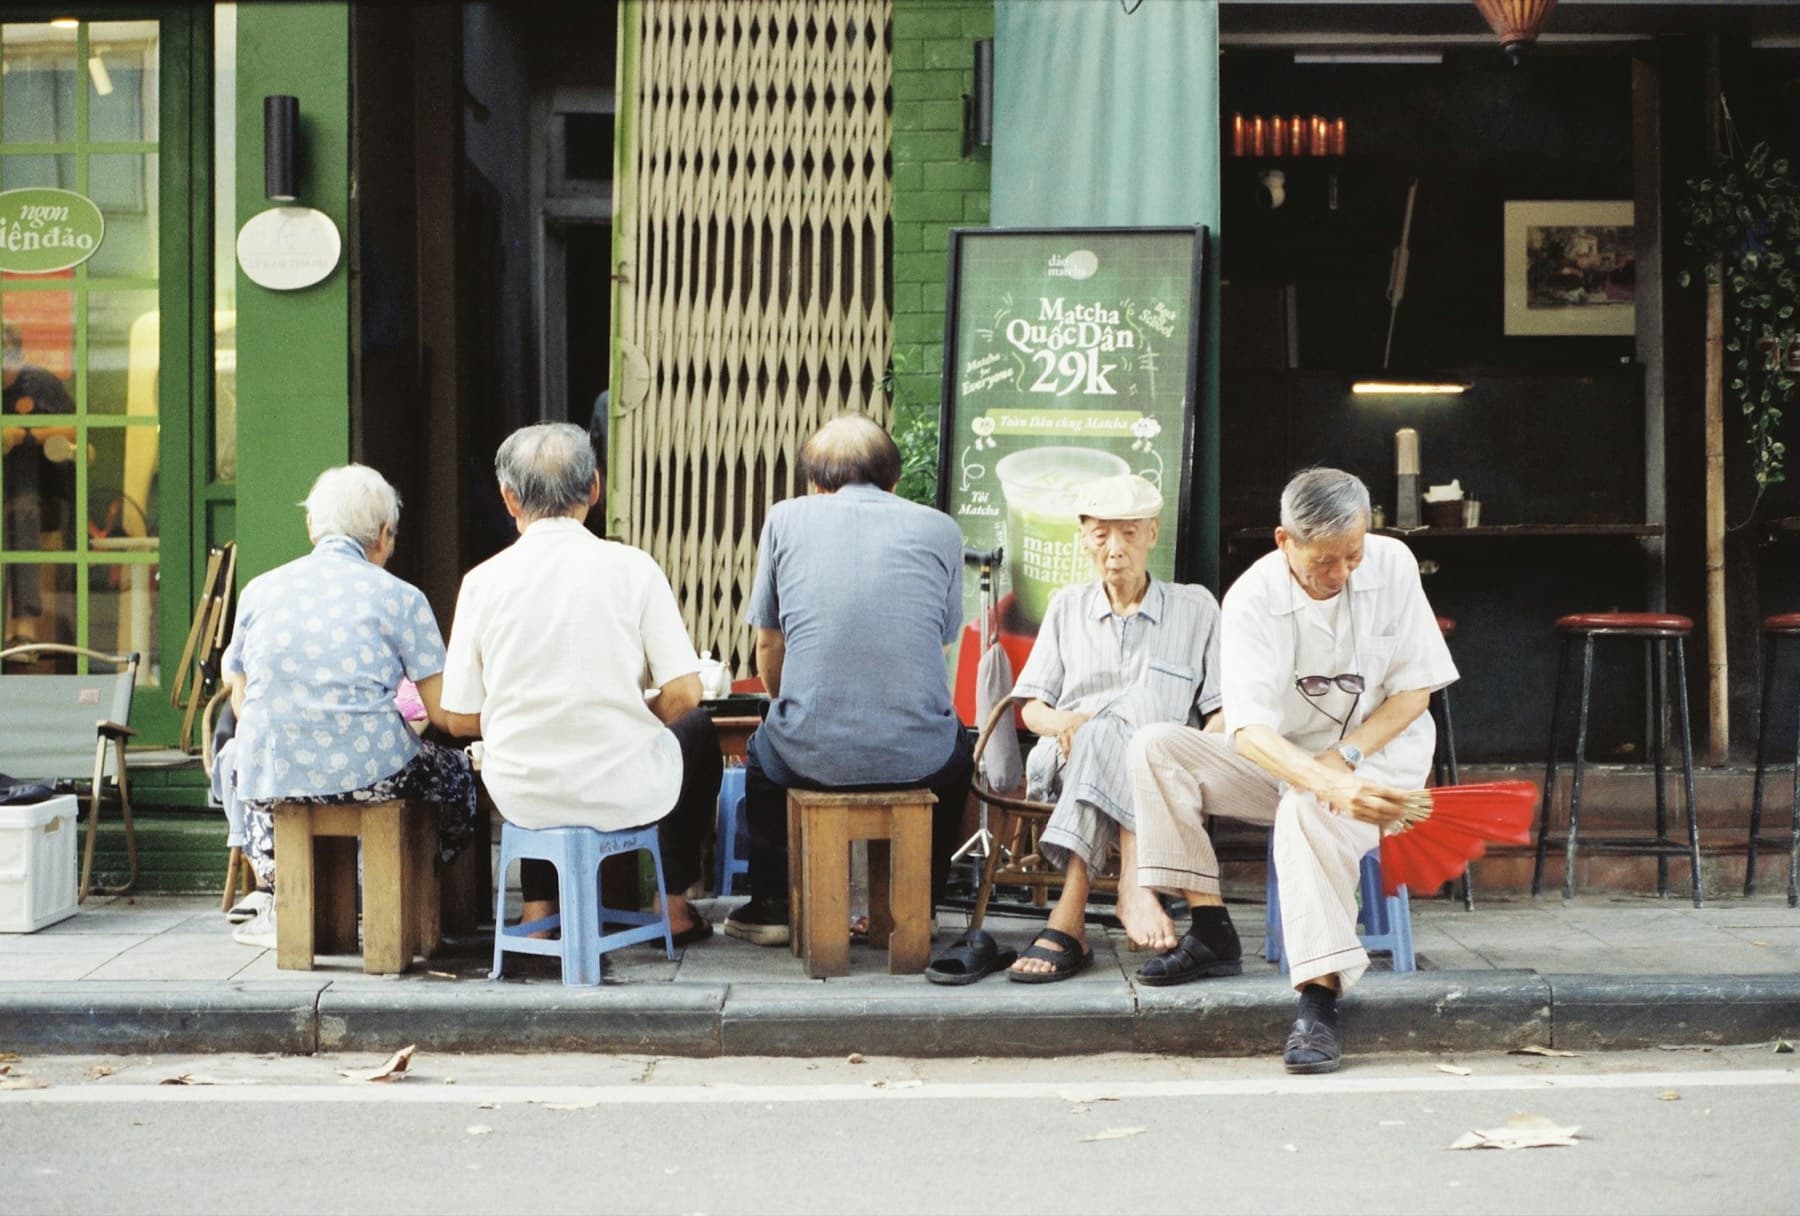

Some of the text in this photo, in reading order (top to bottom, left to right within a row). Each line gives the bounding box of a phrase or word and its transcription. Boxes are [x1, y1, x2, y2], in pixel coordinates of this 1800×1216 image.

[20, 204, 69, 229] ngon
[1038, 296, 1120, 324] Matcha
[1029, 346, 1118, 397] 29k
[1085, 415, 1128, 430] Matcha
[958, 503, 1001, 516] Matcha
